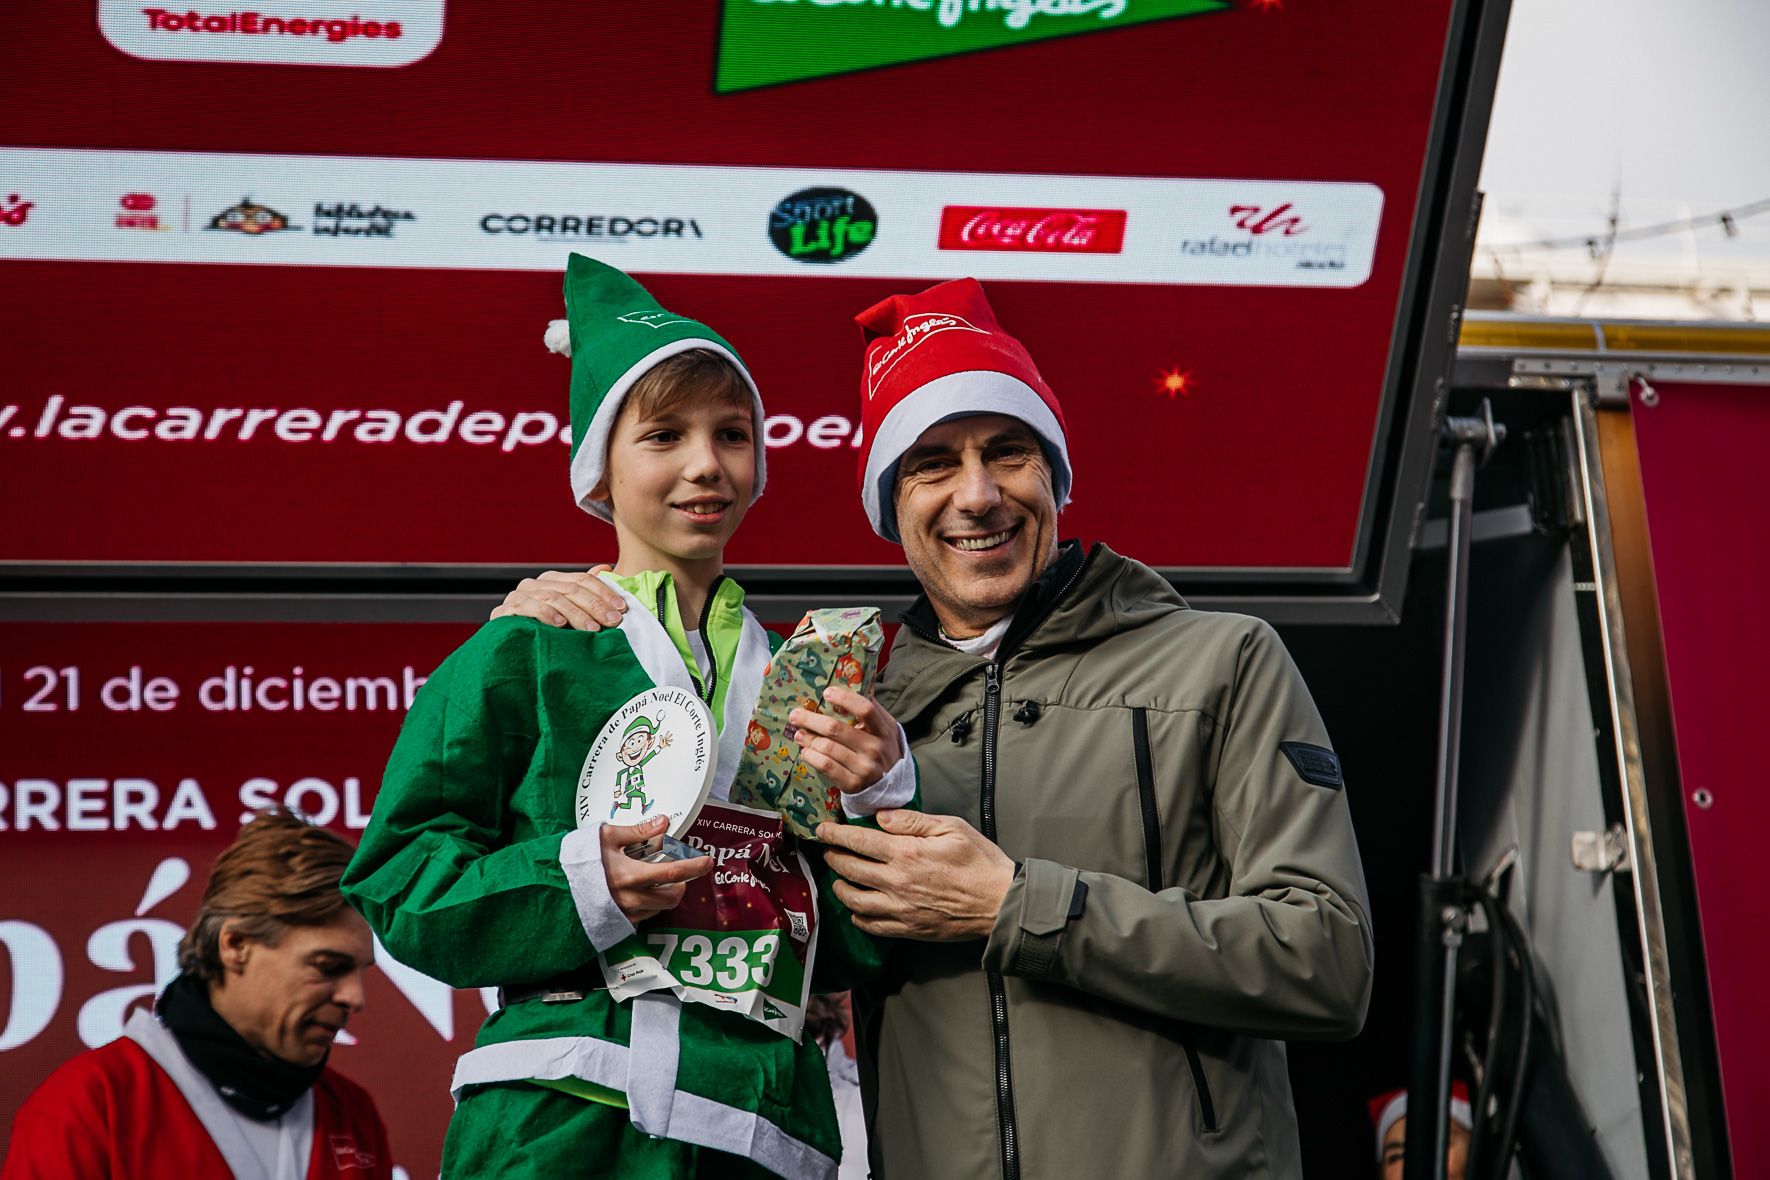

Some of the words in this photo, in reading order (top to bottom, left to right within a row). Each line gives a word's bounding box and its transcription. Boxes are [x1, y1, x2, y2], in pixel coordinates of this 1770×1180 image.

[142, 8, 402, 43] TotalEnergies
[22, 665, 79, 711] 21
[100, 665, 180, 712] de
[650, 691, 675, 704] Noel
[674, 692, 687, 707] El
[621, 696, 647, 720] Papá
[684, 700, 703, 731] Corte
[608, 719, 621, 734] de
[582, 736, 608, 789] Carrera
[694, 731, 707, 772] Inglés
[239, 776, 373, 829] SOL
[580, 795, 590, 821] XIV
[696, 818, 712, 828] XIV
[713, 821, 756, 836] CARRERA
[687, 835, 752, 867] Papá
[725, 870, 750, 884] Corte
[647, 933, 780, 990] 7333
